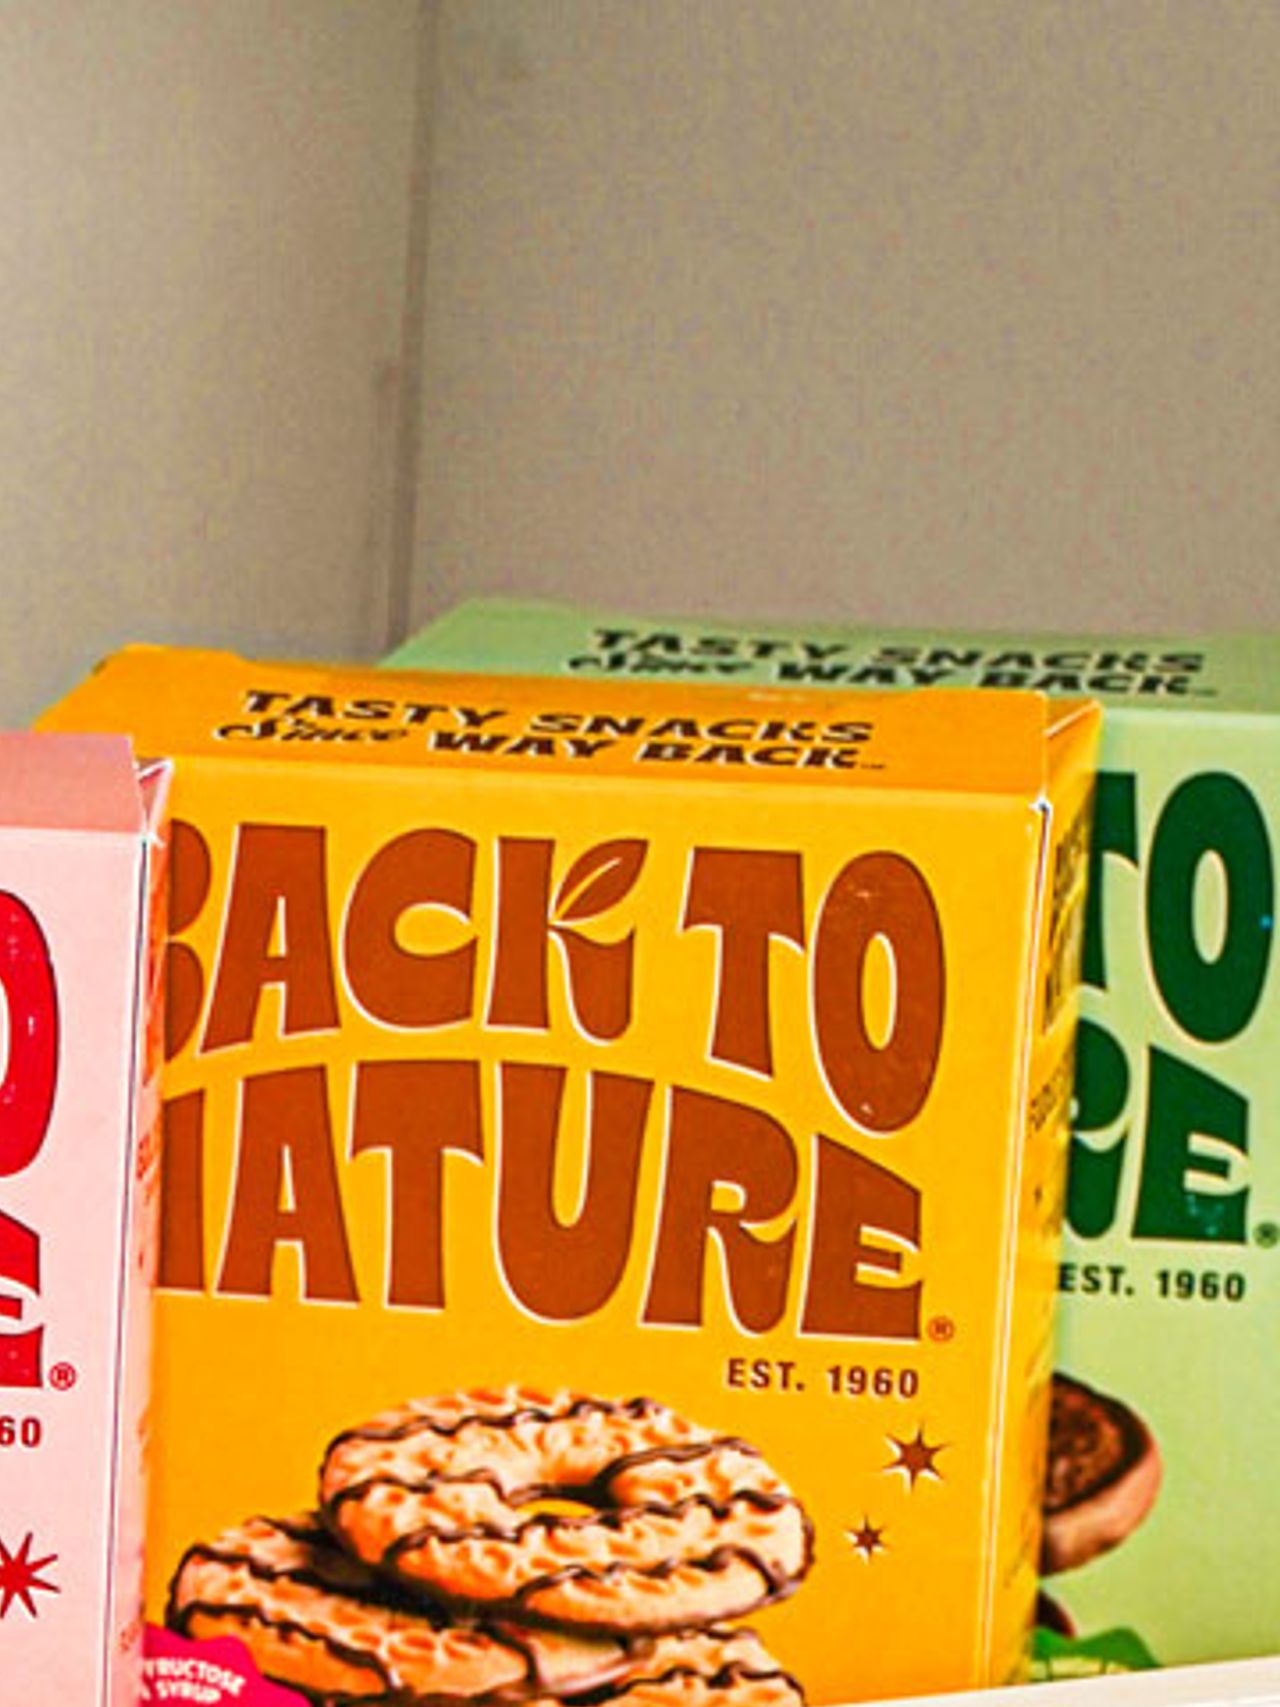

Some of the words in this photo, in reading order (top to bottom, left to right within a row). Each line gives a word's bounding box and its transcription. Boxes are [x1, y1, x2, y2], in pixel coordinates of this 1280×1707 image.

[590, 628, 852, 664] TASTY
[869, 645, 1204, 674] SNACKS
[777, 660, 957, 689] WAY
[213, 716, 410, 750] Since
[427, 731, 607, 762] WAY
[242, 688, 511, 729] TASTY
[528, 714, 874, 744] SNACKS
[682, 846, 945, 1134] TO
[1157, 1271, 1246, 1300] 1960
[727, 1359, 804, 1394] EST.
[825, 1365, 919, 1398] 1960
